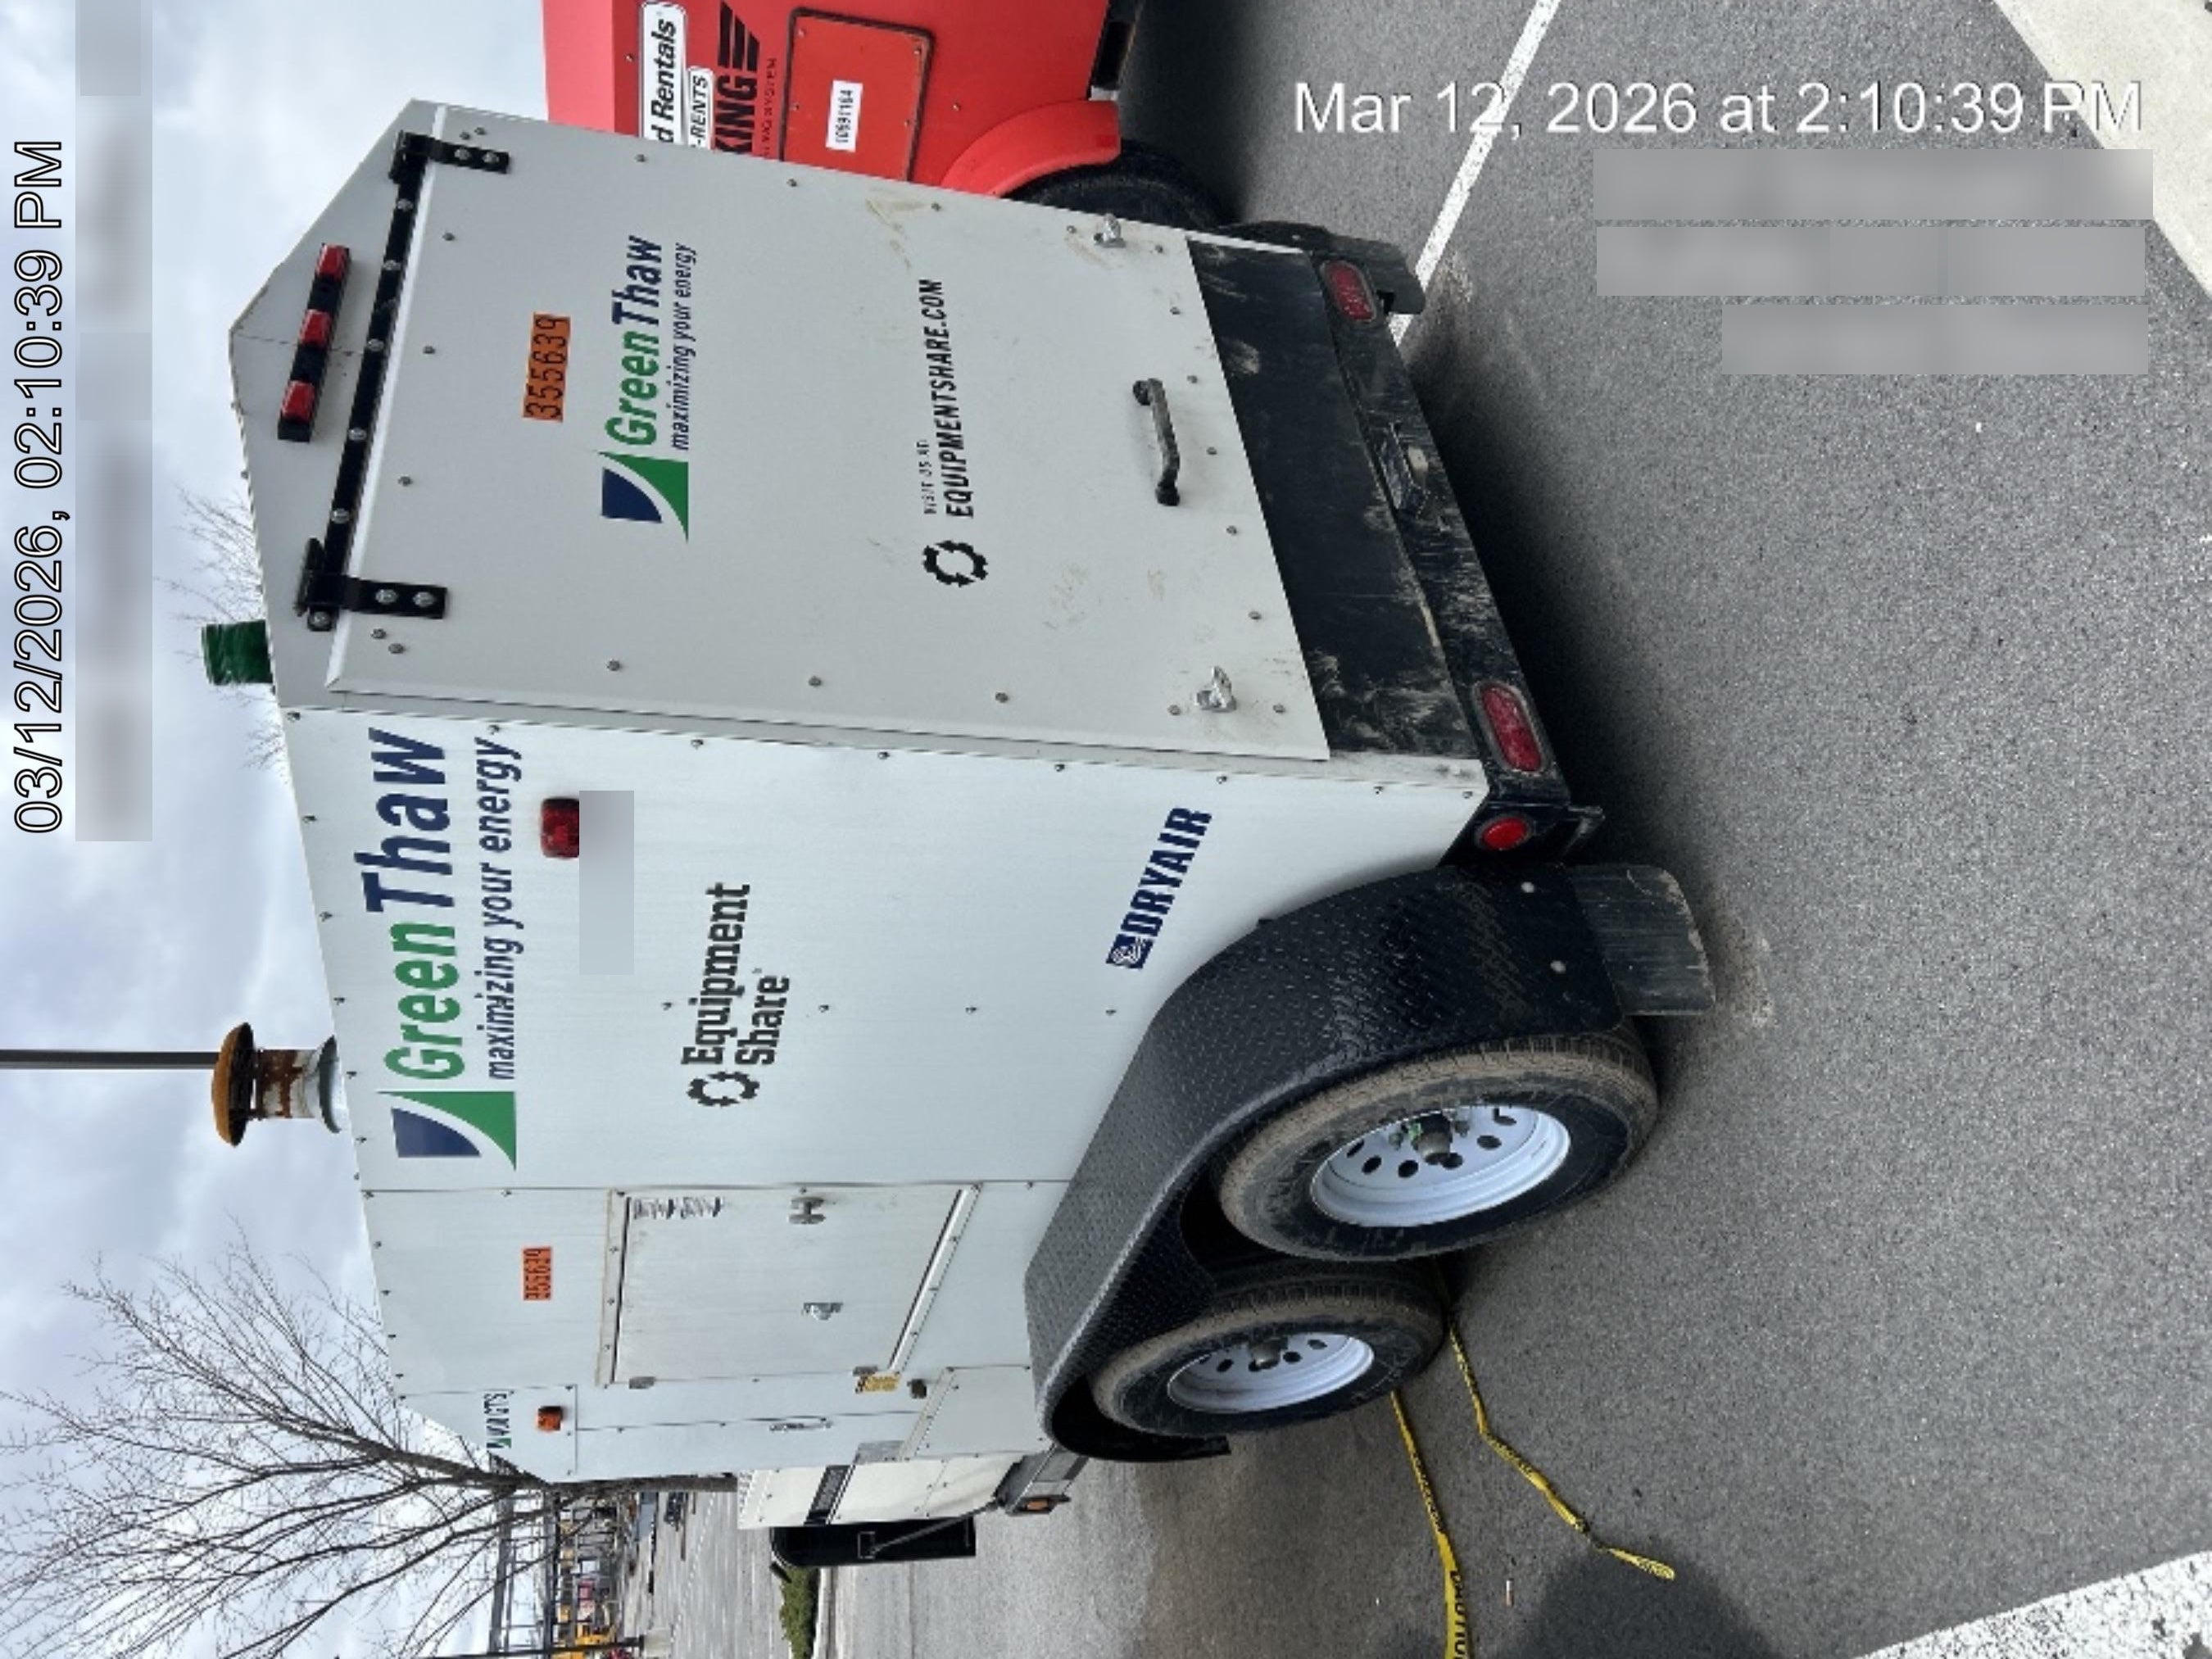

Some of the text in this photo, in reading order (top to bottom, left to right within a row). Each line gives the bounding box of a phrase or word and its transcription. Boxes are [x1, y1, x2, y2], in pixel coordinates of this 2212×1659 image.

[651, 19, 676, 121] Rentals
[691, 75, 708, 147] -RENTS
[525, 315, 569, 419] 355639
[665, 242, 696, 451] maximizing your energy
[918, 279, 974, 519] EQUIPMENTSHARE.COM
[474, 737, 524, 1081] maximizing your energy
[1120, 807, 1212, 937] DRYAIR
[681, 882, 750, 1065] Equipment
[735, 976, 790, 1065] Share
